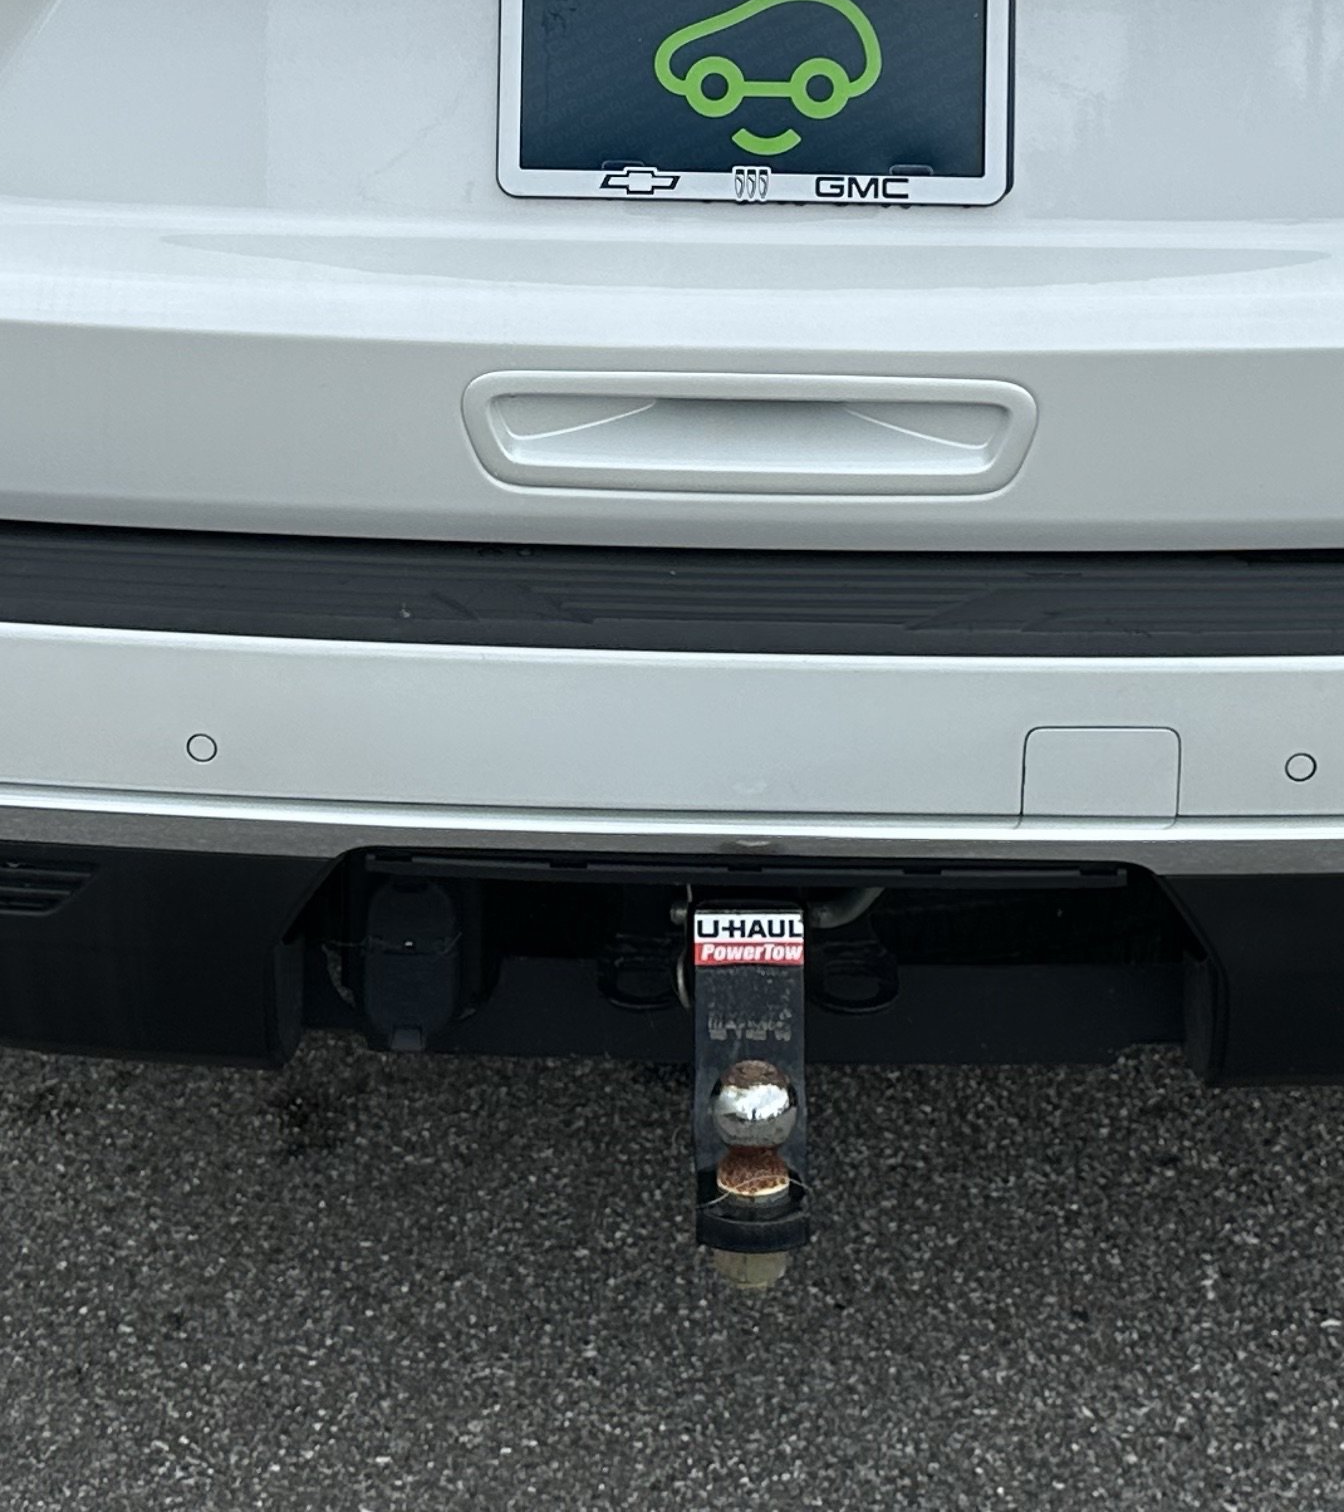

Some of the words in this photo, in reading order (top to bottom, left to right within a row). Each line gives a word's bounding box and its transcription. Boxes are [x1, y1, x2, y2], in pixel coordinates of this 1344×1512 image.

[814, 176, 910, 200] GMC
[696, 918, 804, 938] U-HAUL
[700, 943, 803, 962] PowerTow
